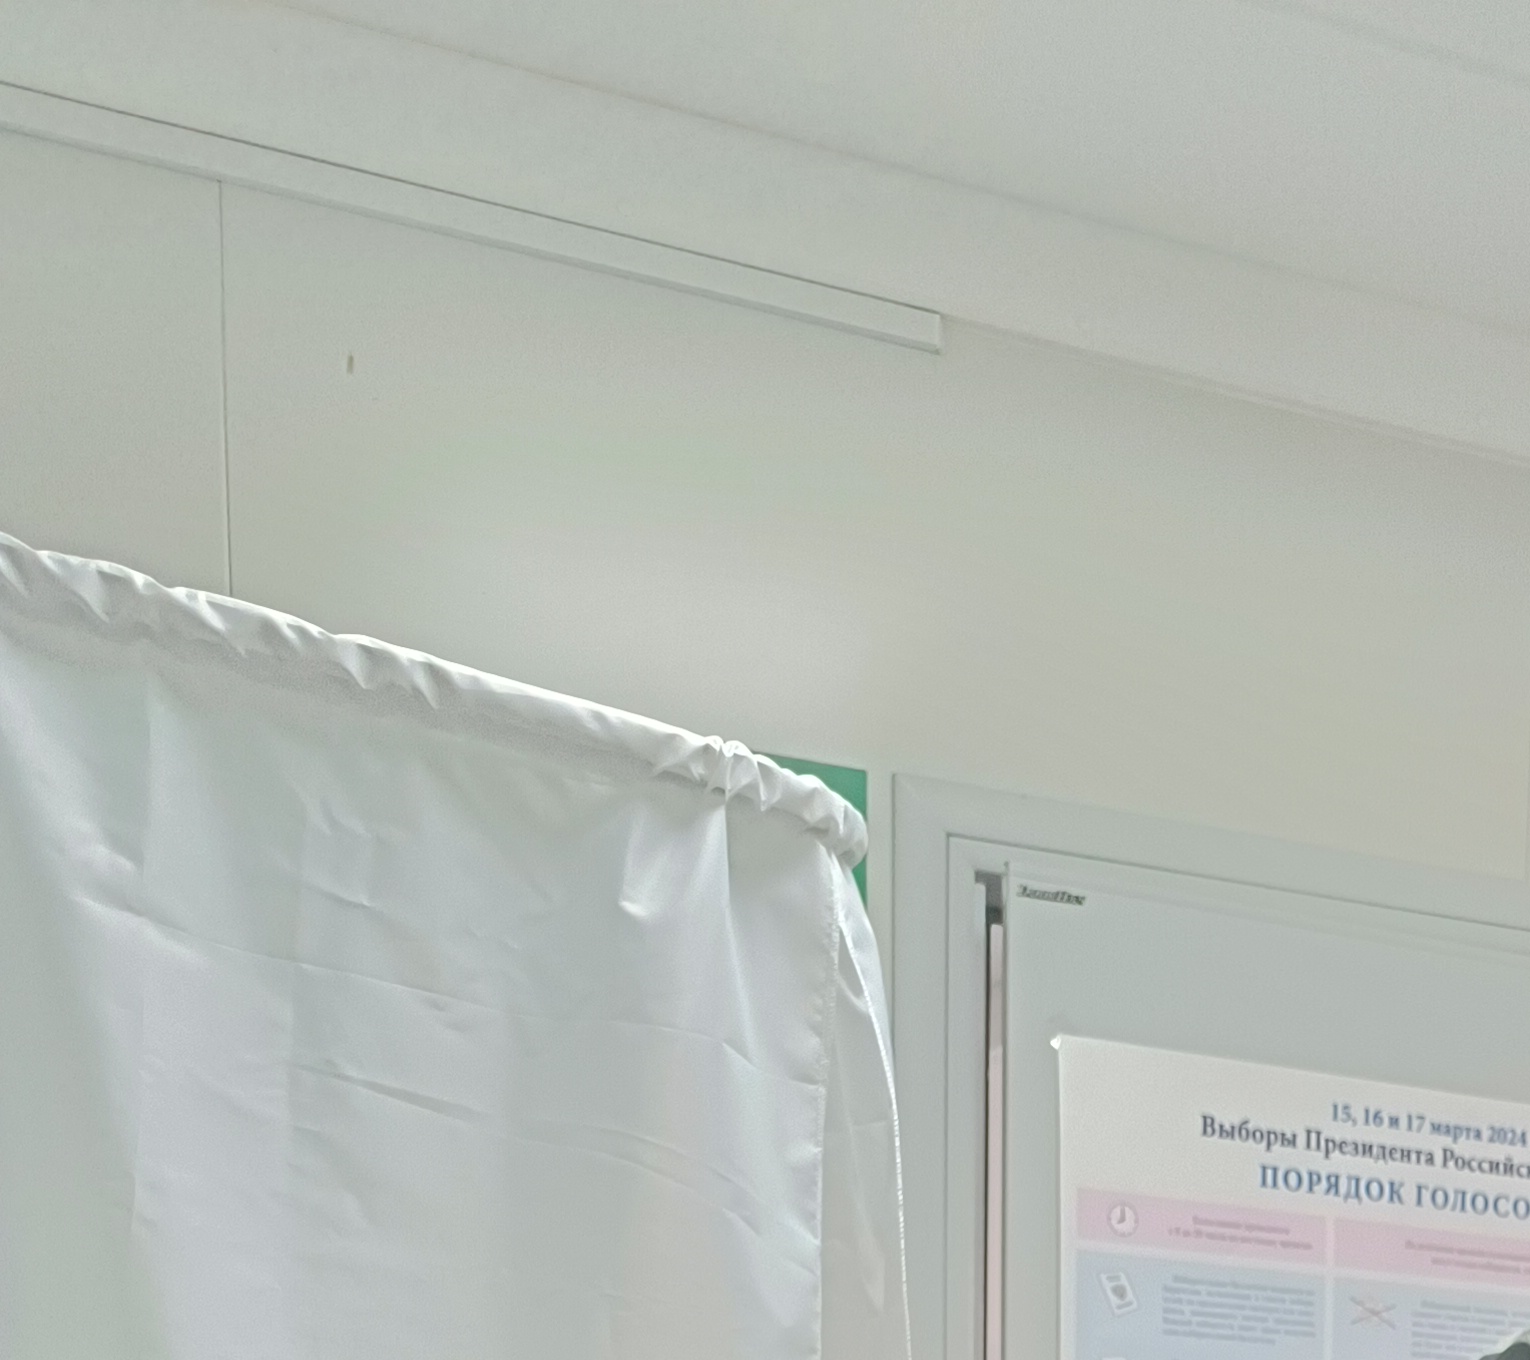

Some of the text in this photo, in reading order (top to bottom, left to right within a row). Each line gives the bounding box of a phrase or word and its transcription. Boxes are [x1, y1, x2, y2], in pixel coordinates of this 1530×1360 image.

[1201, 1114, 1297, 1151] Выборы
[1304, 1128, 1435, 1166] Президента
[1331, 1103, 1358, 1127] 15,
[1364, 1107, 1384, 1128] 16
[1388, 1115, 1400, 1131] и
[1406, 1114, 1426, 1133] 17
[1429, 1121, 1483, 1144] марта
[1487, 1125, 1527, 1147] 2024
[1259, 1164, 1405, 1205] ПОРЯДОК
